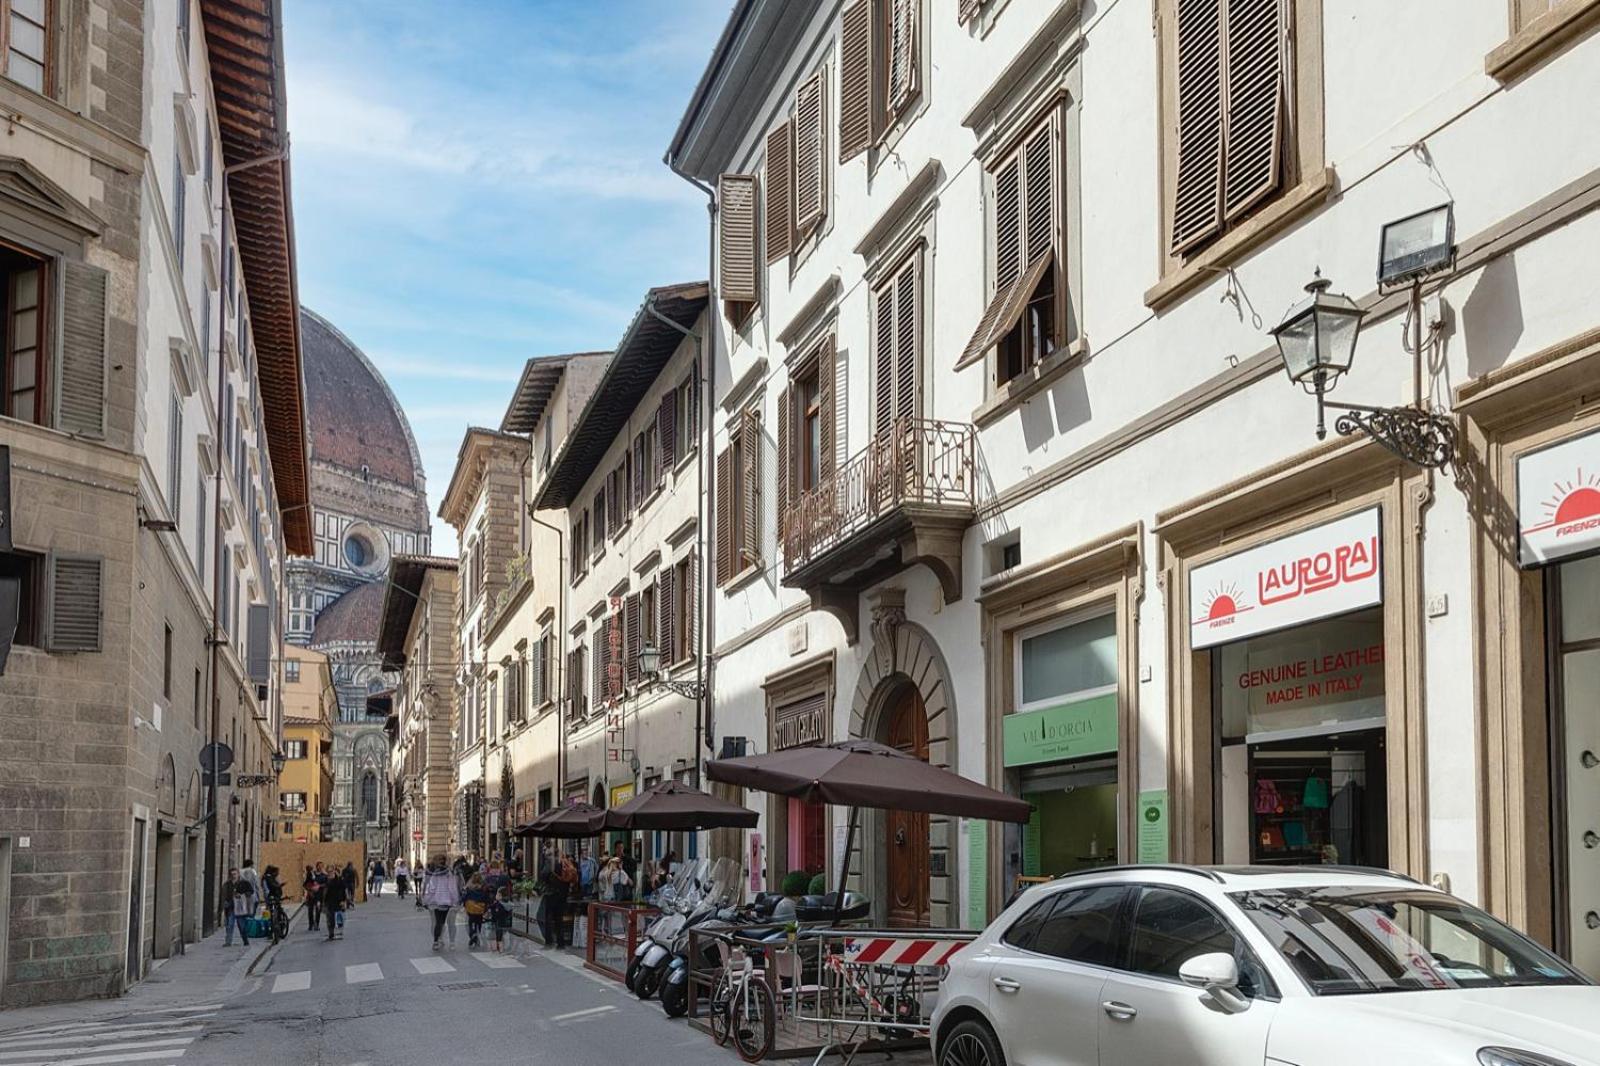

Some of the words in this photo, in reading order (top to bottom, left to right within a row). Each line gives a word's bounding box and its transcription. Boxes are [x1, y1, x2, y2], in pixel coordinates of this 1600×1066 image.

[1556, 519, 1600, 537] FIRENZ
[1209, 616, 1236, 629] FIRENZE
[1239, 661, 1307, 689] GENUINE
[1313, 642, 1385, 674] LEATHE
[1266, 688, 1303, 705] MADE
[1308, 682, 1321, 697] IN
[1325, 675, 1363, 695] ITALY
